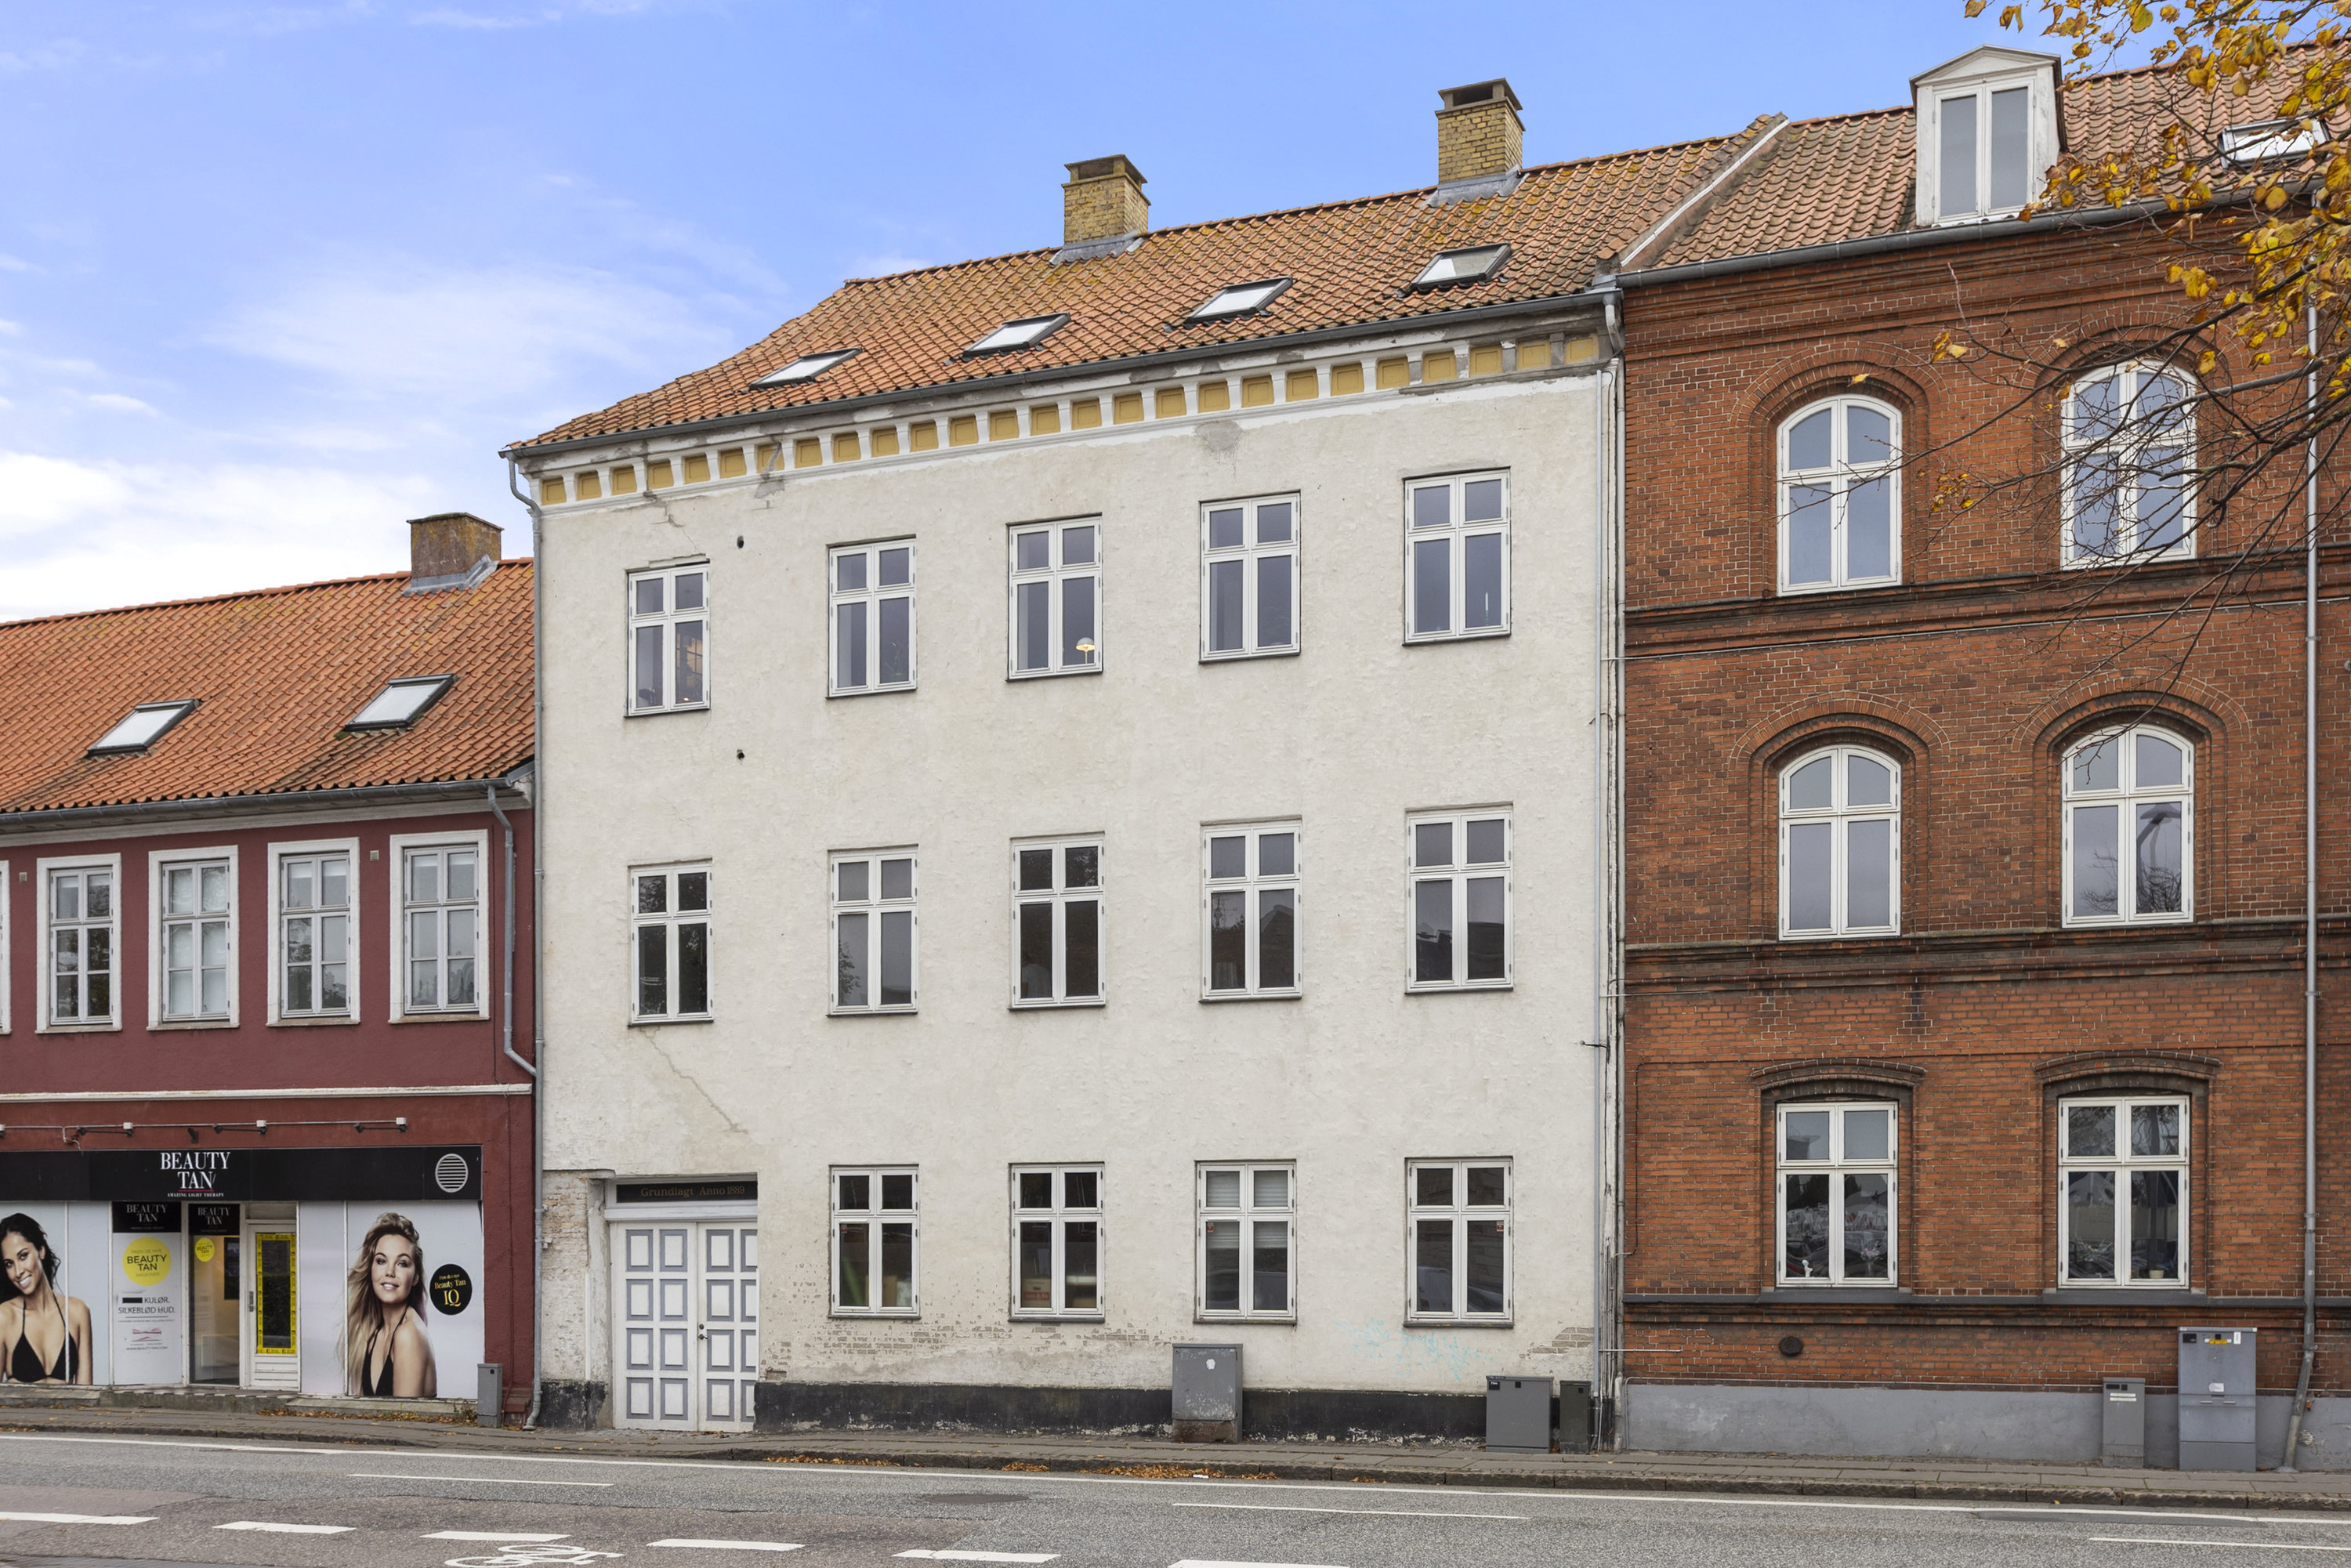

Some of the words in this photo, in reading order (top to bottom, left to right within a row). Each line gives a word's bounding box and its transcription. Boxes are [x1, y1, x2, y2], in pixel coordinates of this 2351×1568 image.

[160, 1151, 231, 1170] BEAUTY
[177, 1171, 215, 1190] TAN
[640, 1186, 694, 1198] Grundlagt
[699, 1186, 726, 1196] Anno
[726, 1185, 744, 1196] 1889
[126, 1204, 168, 1214] BEAUTY
[197, 1207, 230, 1216] BEAUTY
[136, 1214, 158, 1222] TAN
[205, 1216, 223, 1225] TAN
[127, 1254, 167, 1264] BEAUTY
[137, 1263, 158, 1272] TAN
[434, 1280, 453, 1290] Beauty
[443, 1289, 462, 1307] IQ
[158, 1305, 176, 1314] HUD.
